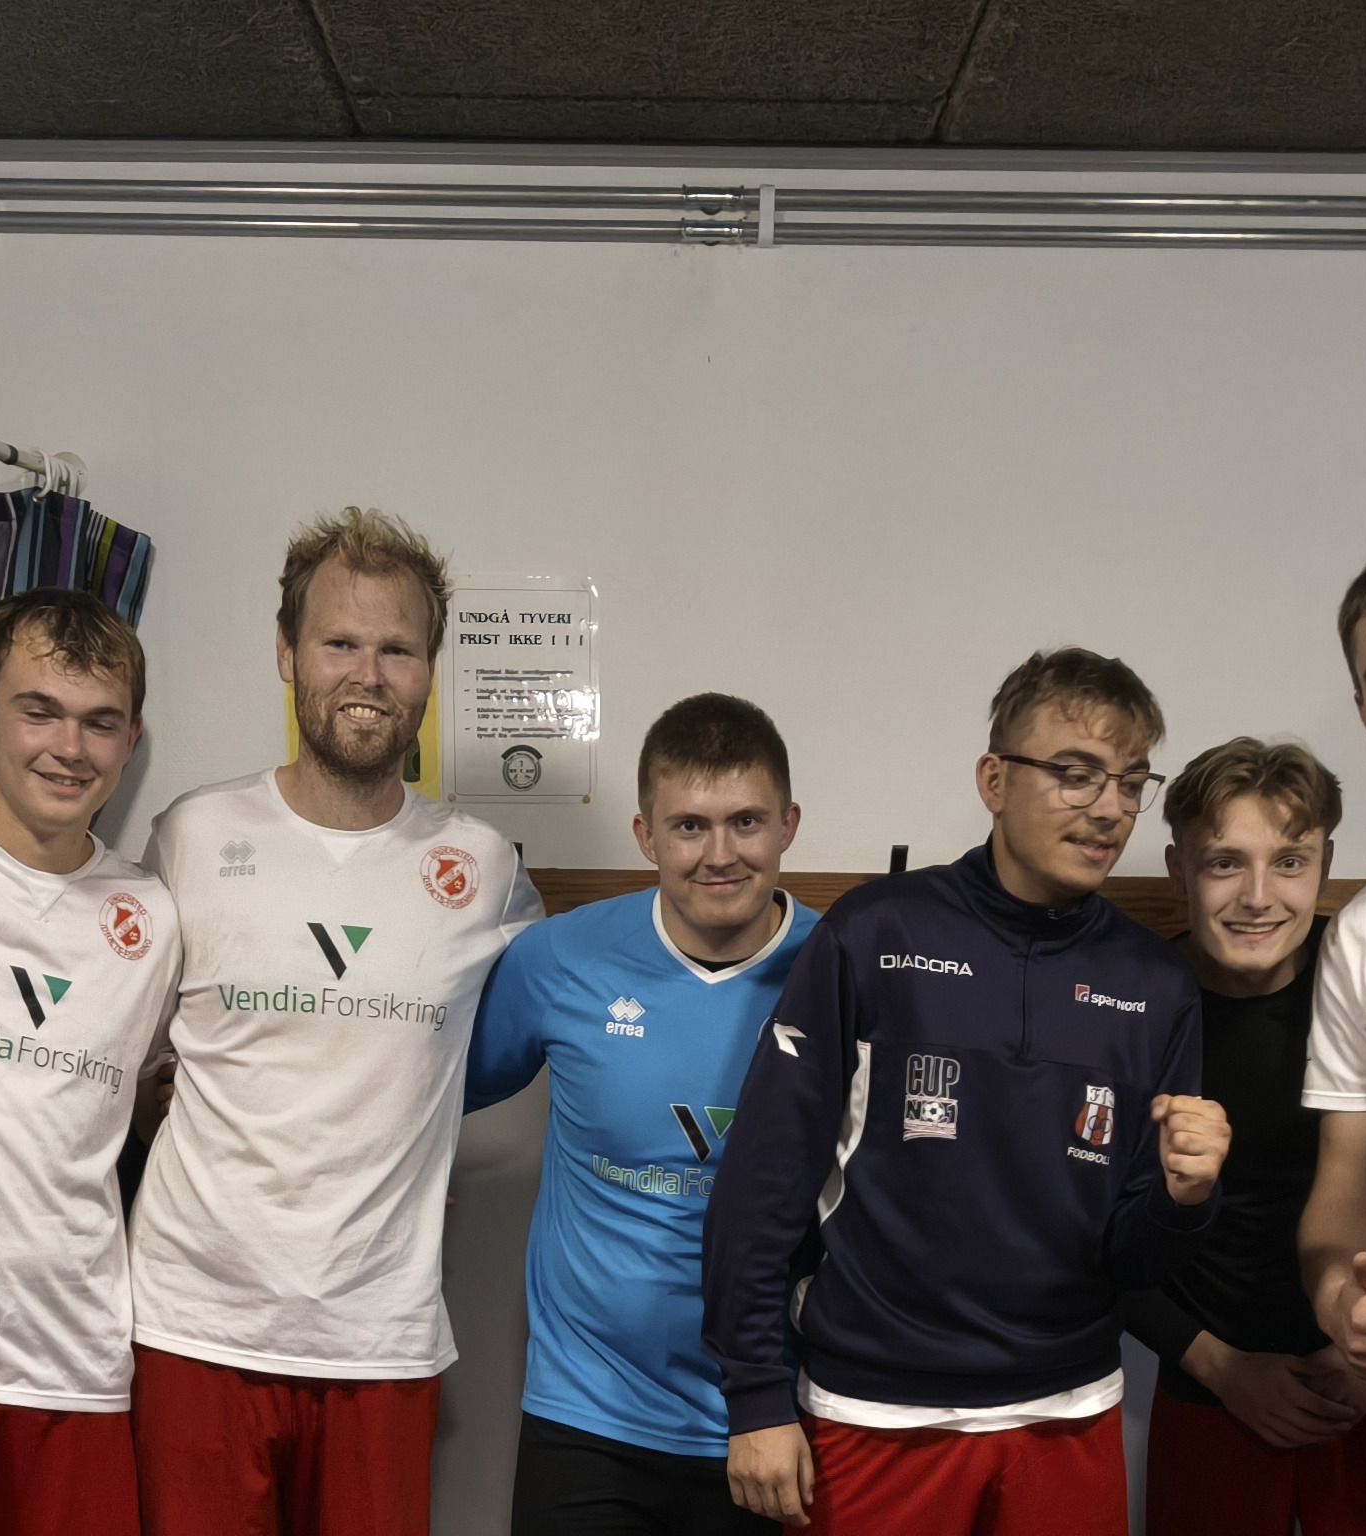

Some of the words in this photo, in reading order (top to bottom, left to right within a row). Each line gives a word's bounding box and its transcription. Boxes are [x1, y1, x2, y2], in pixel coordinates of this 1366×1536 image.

[459, 609, 510, 623] UNDGÅ
[519, 613, 571, 624] TYVERI
[460, 634, 500, 645] FRIST
[509, 635, 542, 645] IKKE
[219, 864, 255, 877] errea
[880, 954, 973, 976] DIADORA
[218, 984, 447, 1031] VendiaForsikring
[606, 1021, 645, 1038] errea
[906, 1053, 960, 1098] CUP
[592, 1155, 716, 1198] VendiaFo
